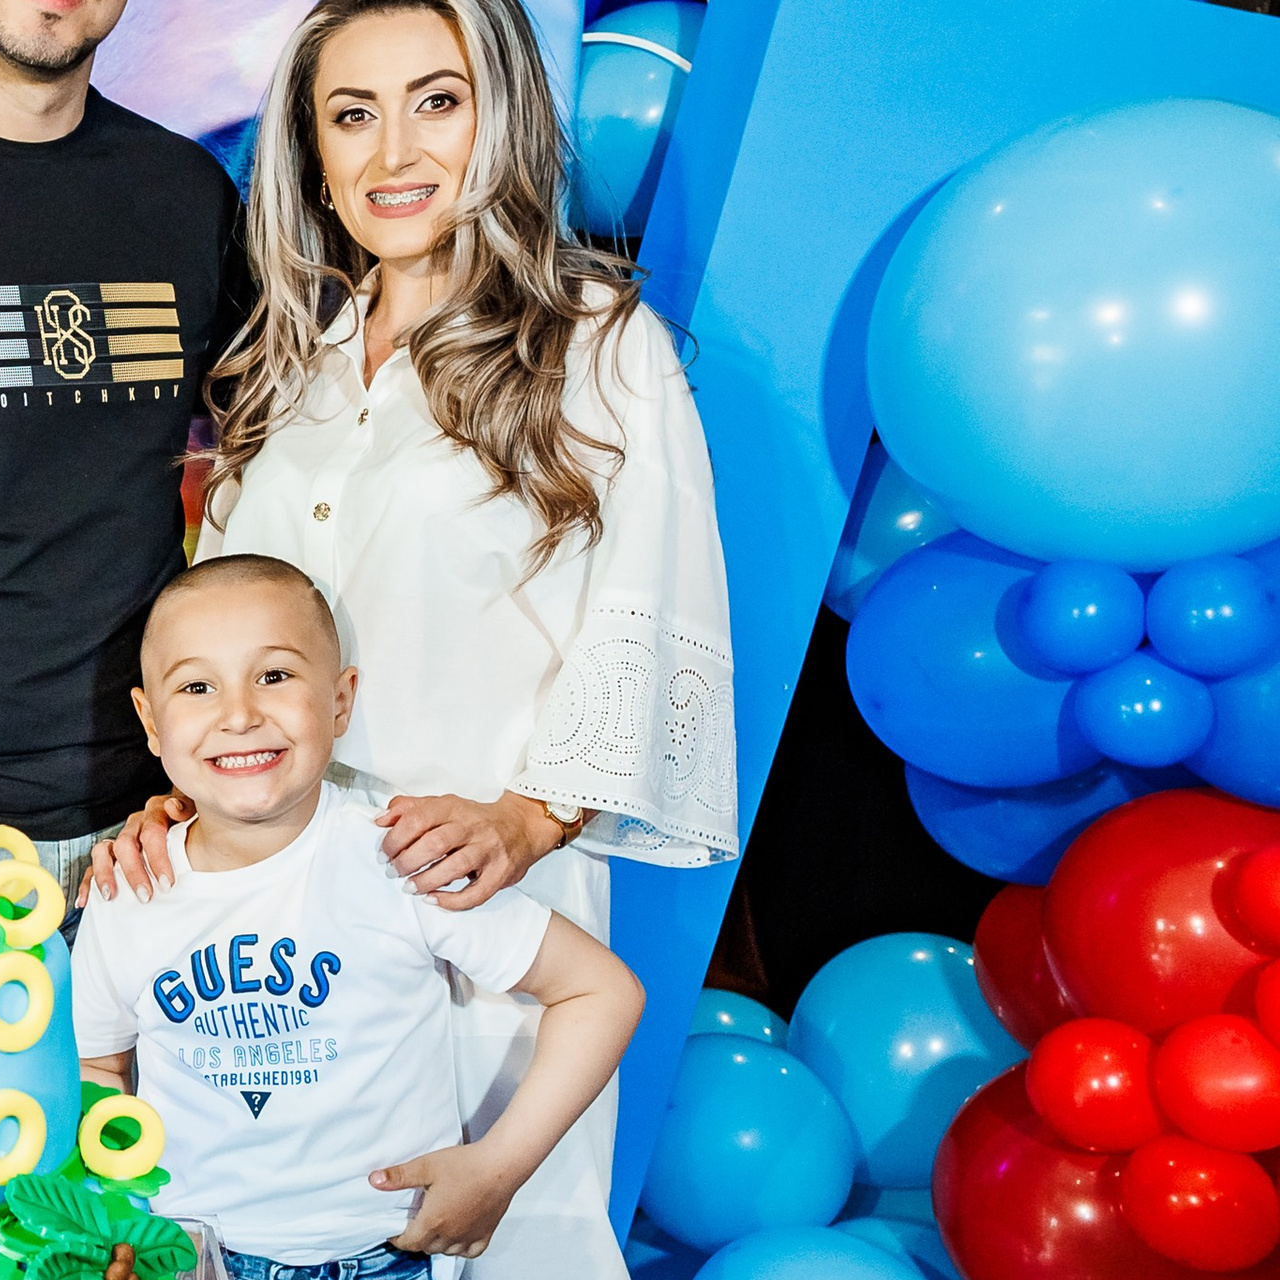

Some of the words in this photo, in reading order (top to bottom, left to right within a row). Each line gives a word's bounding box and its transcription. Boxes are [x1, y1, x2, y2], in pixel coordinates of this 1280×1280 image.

[153, 934, 341, 1023] GUESS
[194, 1002, 310, 1040] AUTHENTIC
[178, 1046, 222, 1070] LOS
[233, 1038, 339, 1068] ANGELES
